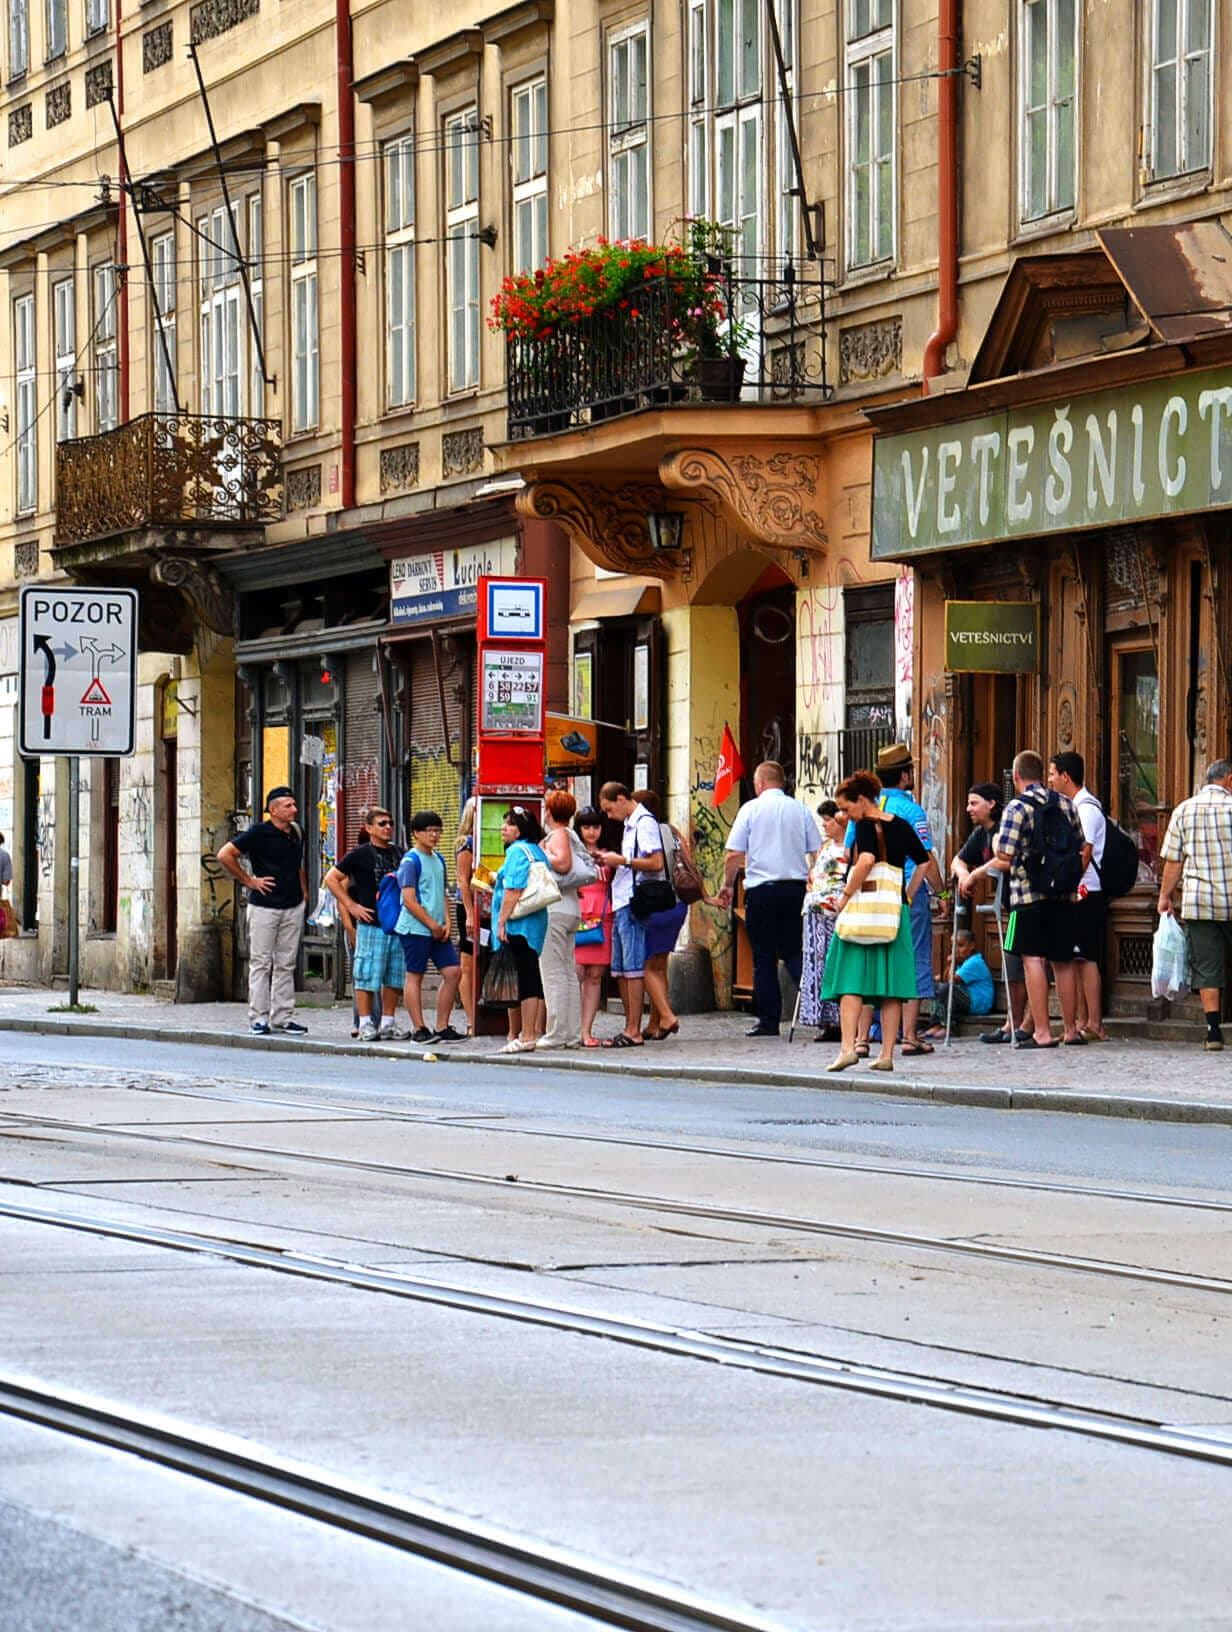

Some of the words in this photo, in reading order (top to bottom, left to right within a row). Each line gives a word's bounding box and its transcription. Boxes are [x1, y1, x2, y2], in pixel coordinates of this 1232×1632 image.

[34, 600, 122, 625] POZOR
[488, 681, 495, 690] 6
[499, 682, 511, 692] 58
[512, 682, 524, 691] 22
[526, 682, 538, 692] 57
[488, 692, 495, 700] 9
[499, 692, 511, 701] 59
[526, 694, 537, 702] 91
[79, 706, 112, 717] TRAM
